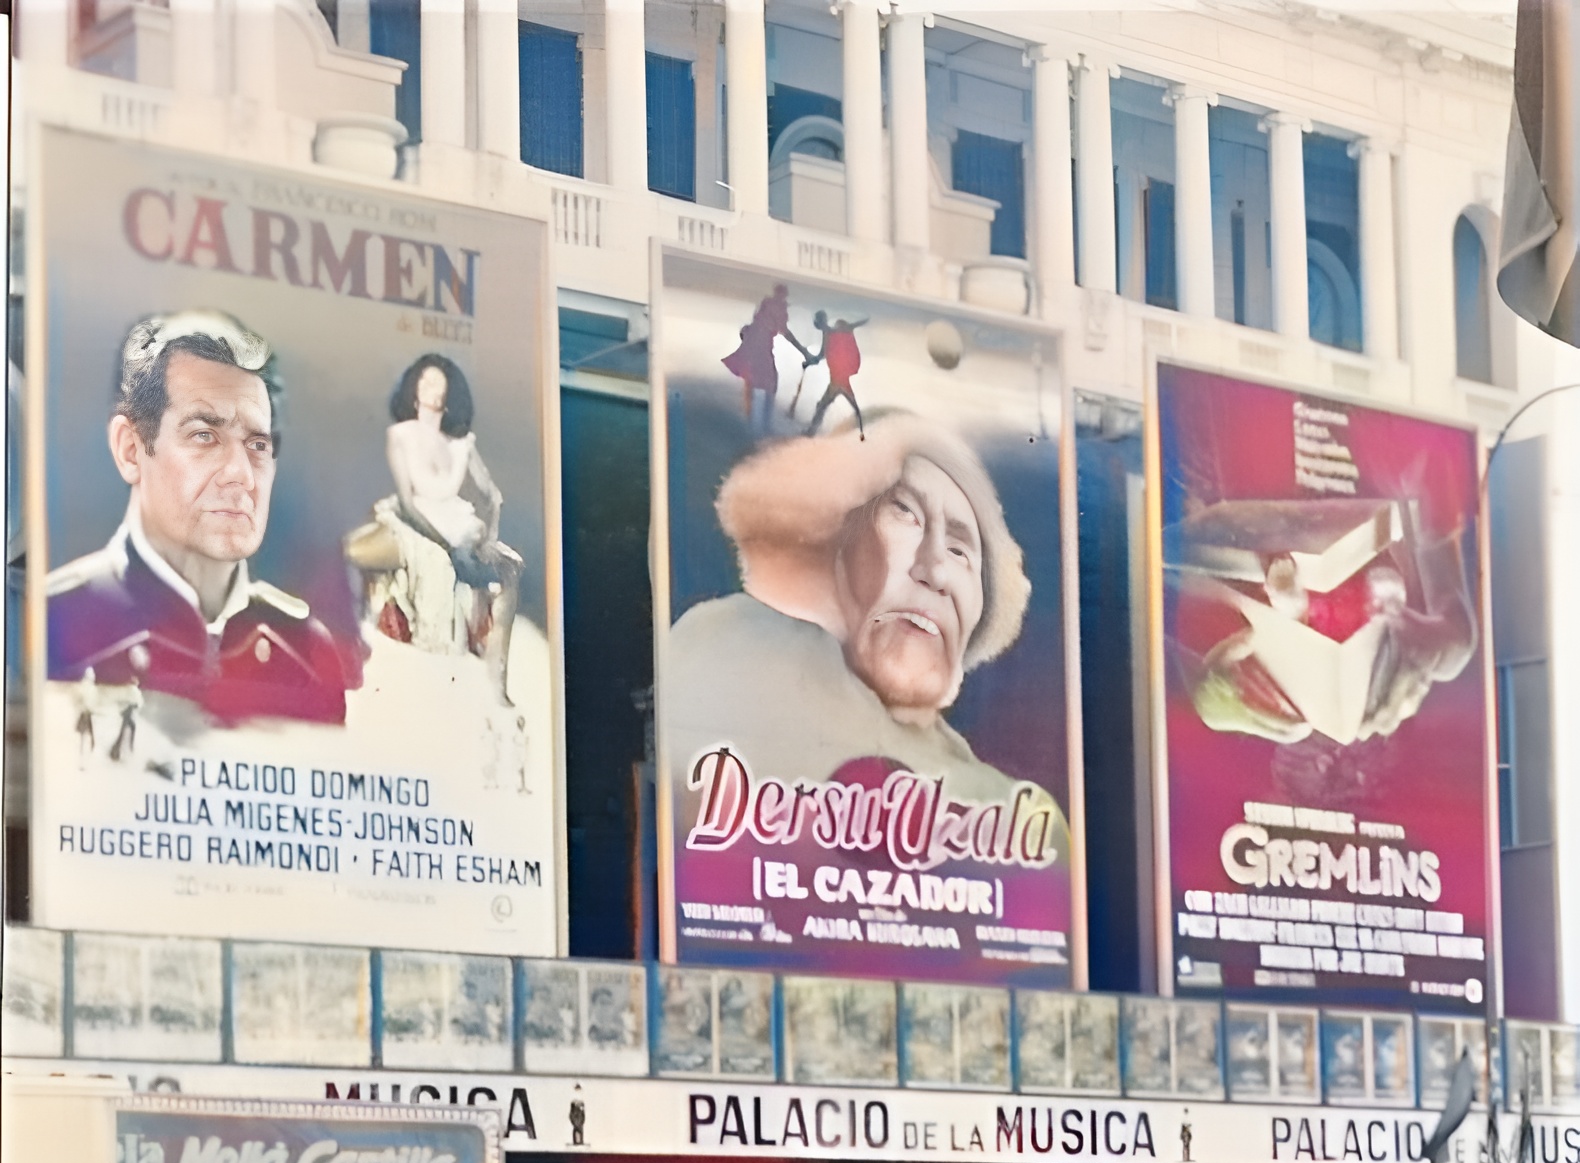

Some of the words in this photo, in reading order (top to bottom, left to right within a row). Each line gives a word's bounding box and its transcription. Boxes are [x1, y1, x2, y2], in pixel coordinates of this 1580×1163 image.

[122, 186, 482, 317] CARMEN
[311, 769, 430, 807] DOMINGO
[687, 742, 884, 851] Dersu
[882, 770, 1058, 871] Uzala
[135, 793, 213, 827] JULIA
[225, 800, 474, 847] MIGENES-JOHNSON
[59, 825, 192, 862] RUGGERO
[207, 836, 339, 874] RAIMONDI
[372, 849, 443, 880] FAITH
[456, 855, 542, 887] ESHAM
[688, 1093, 890, 1149] PALACIO
[903, 1121, 938, 1151] DE
[950, 1123, 985, 1152] LA
[996, 1105, 1157, 1158] MUSICA
[1271, 1116, 1426, 1163] PALACIO
